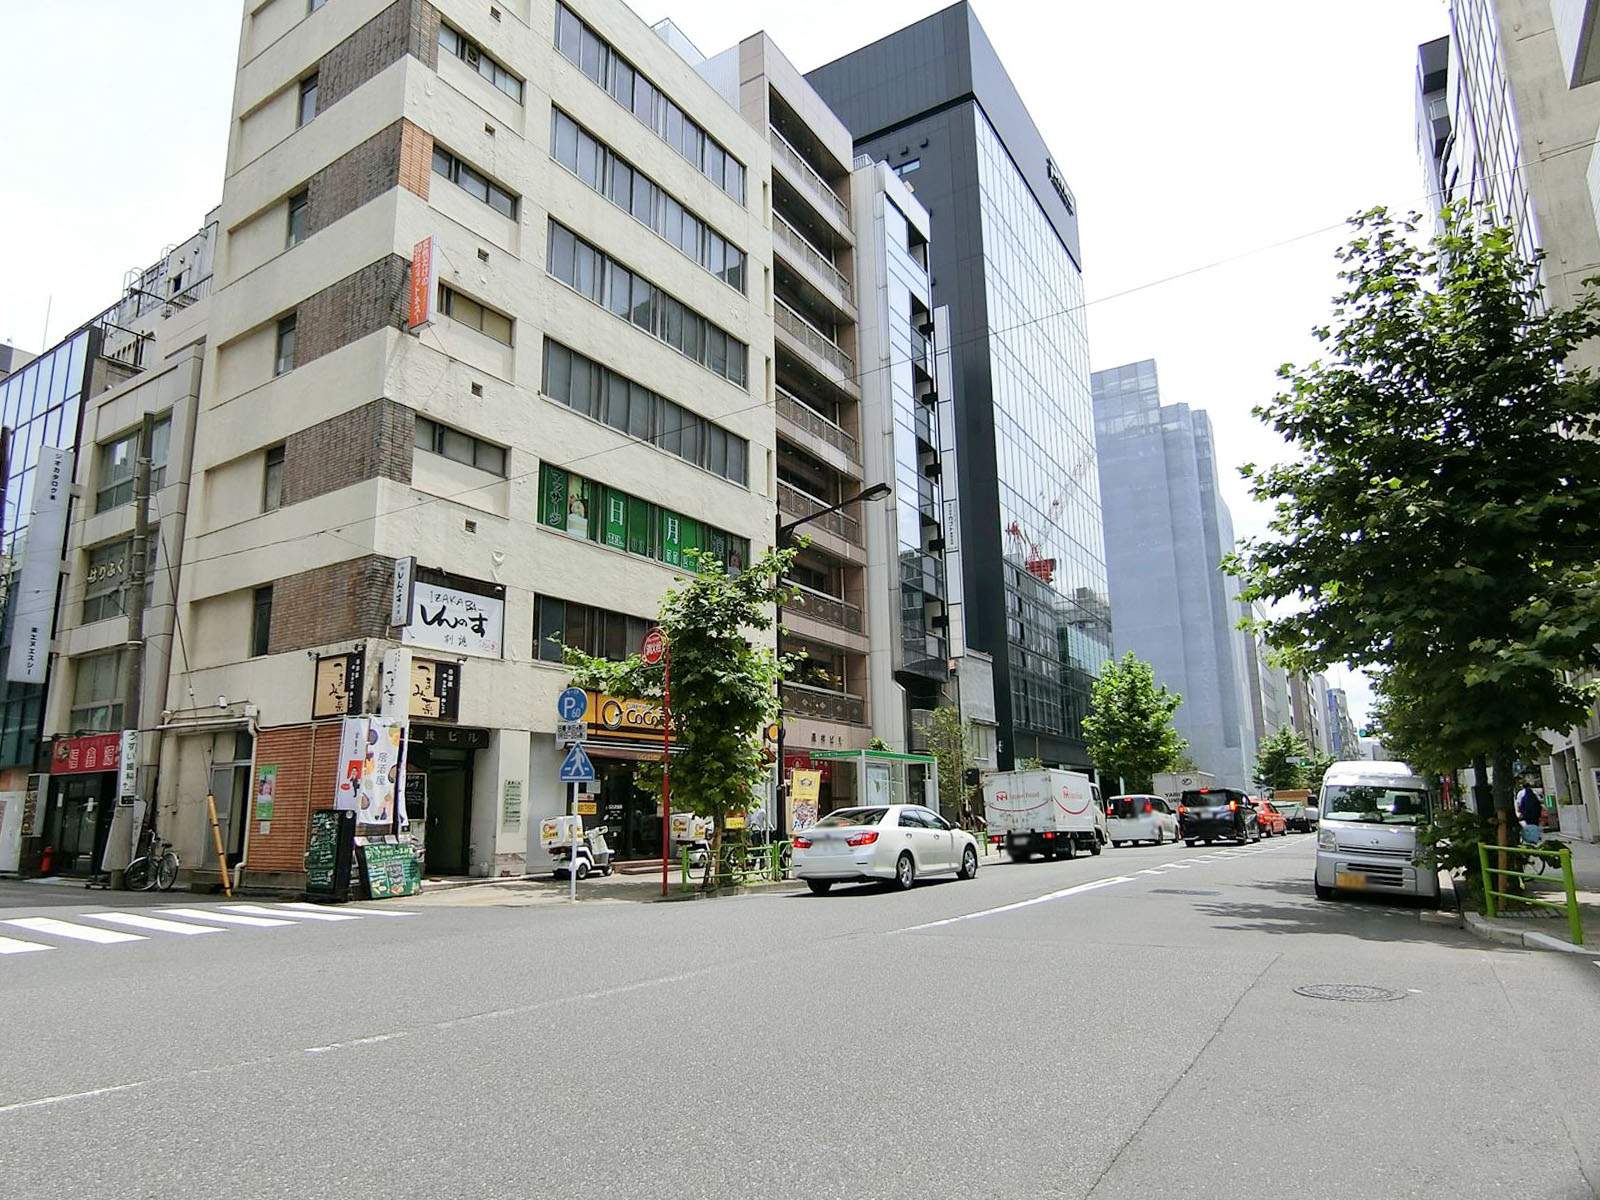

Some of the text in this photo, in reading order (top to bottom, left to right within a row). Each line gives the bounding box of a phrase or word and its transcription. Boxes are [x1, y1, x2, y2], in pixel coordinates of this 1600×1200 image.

[419, 603, 489, 638] しんのす
[563, 696, 576, 718] P
